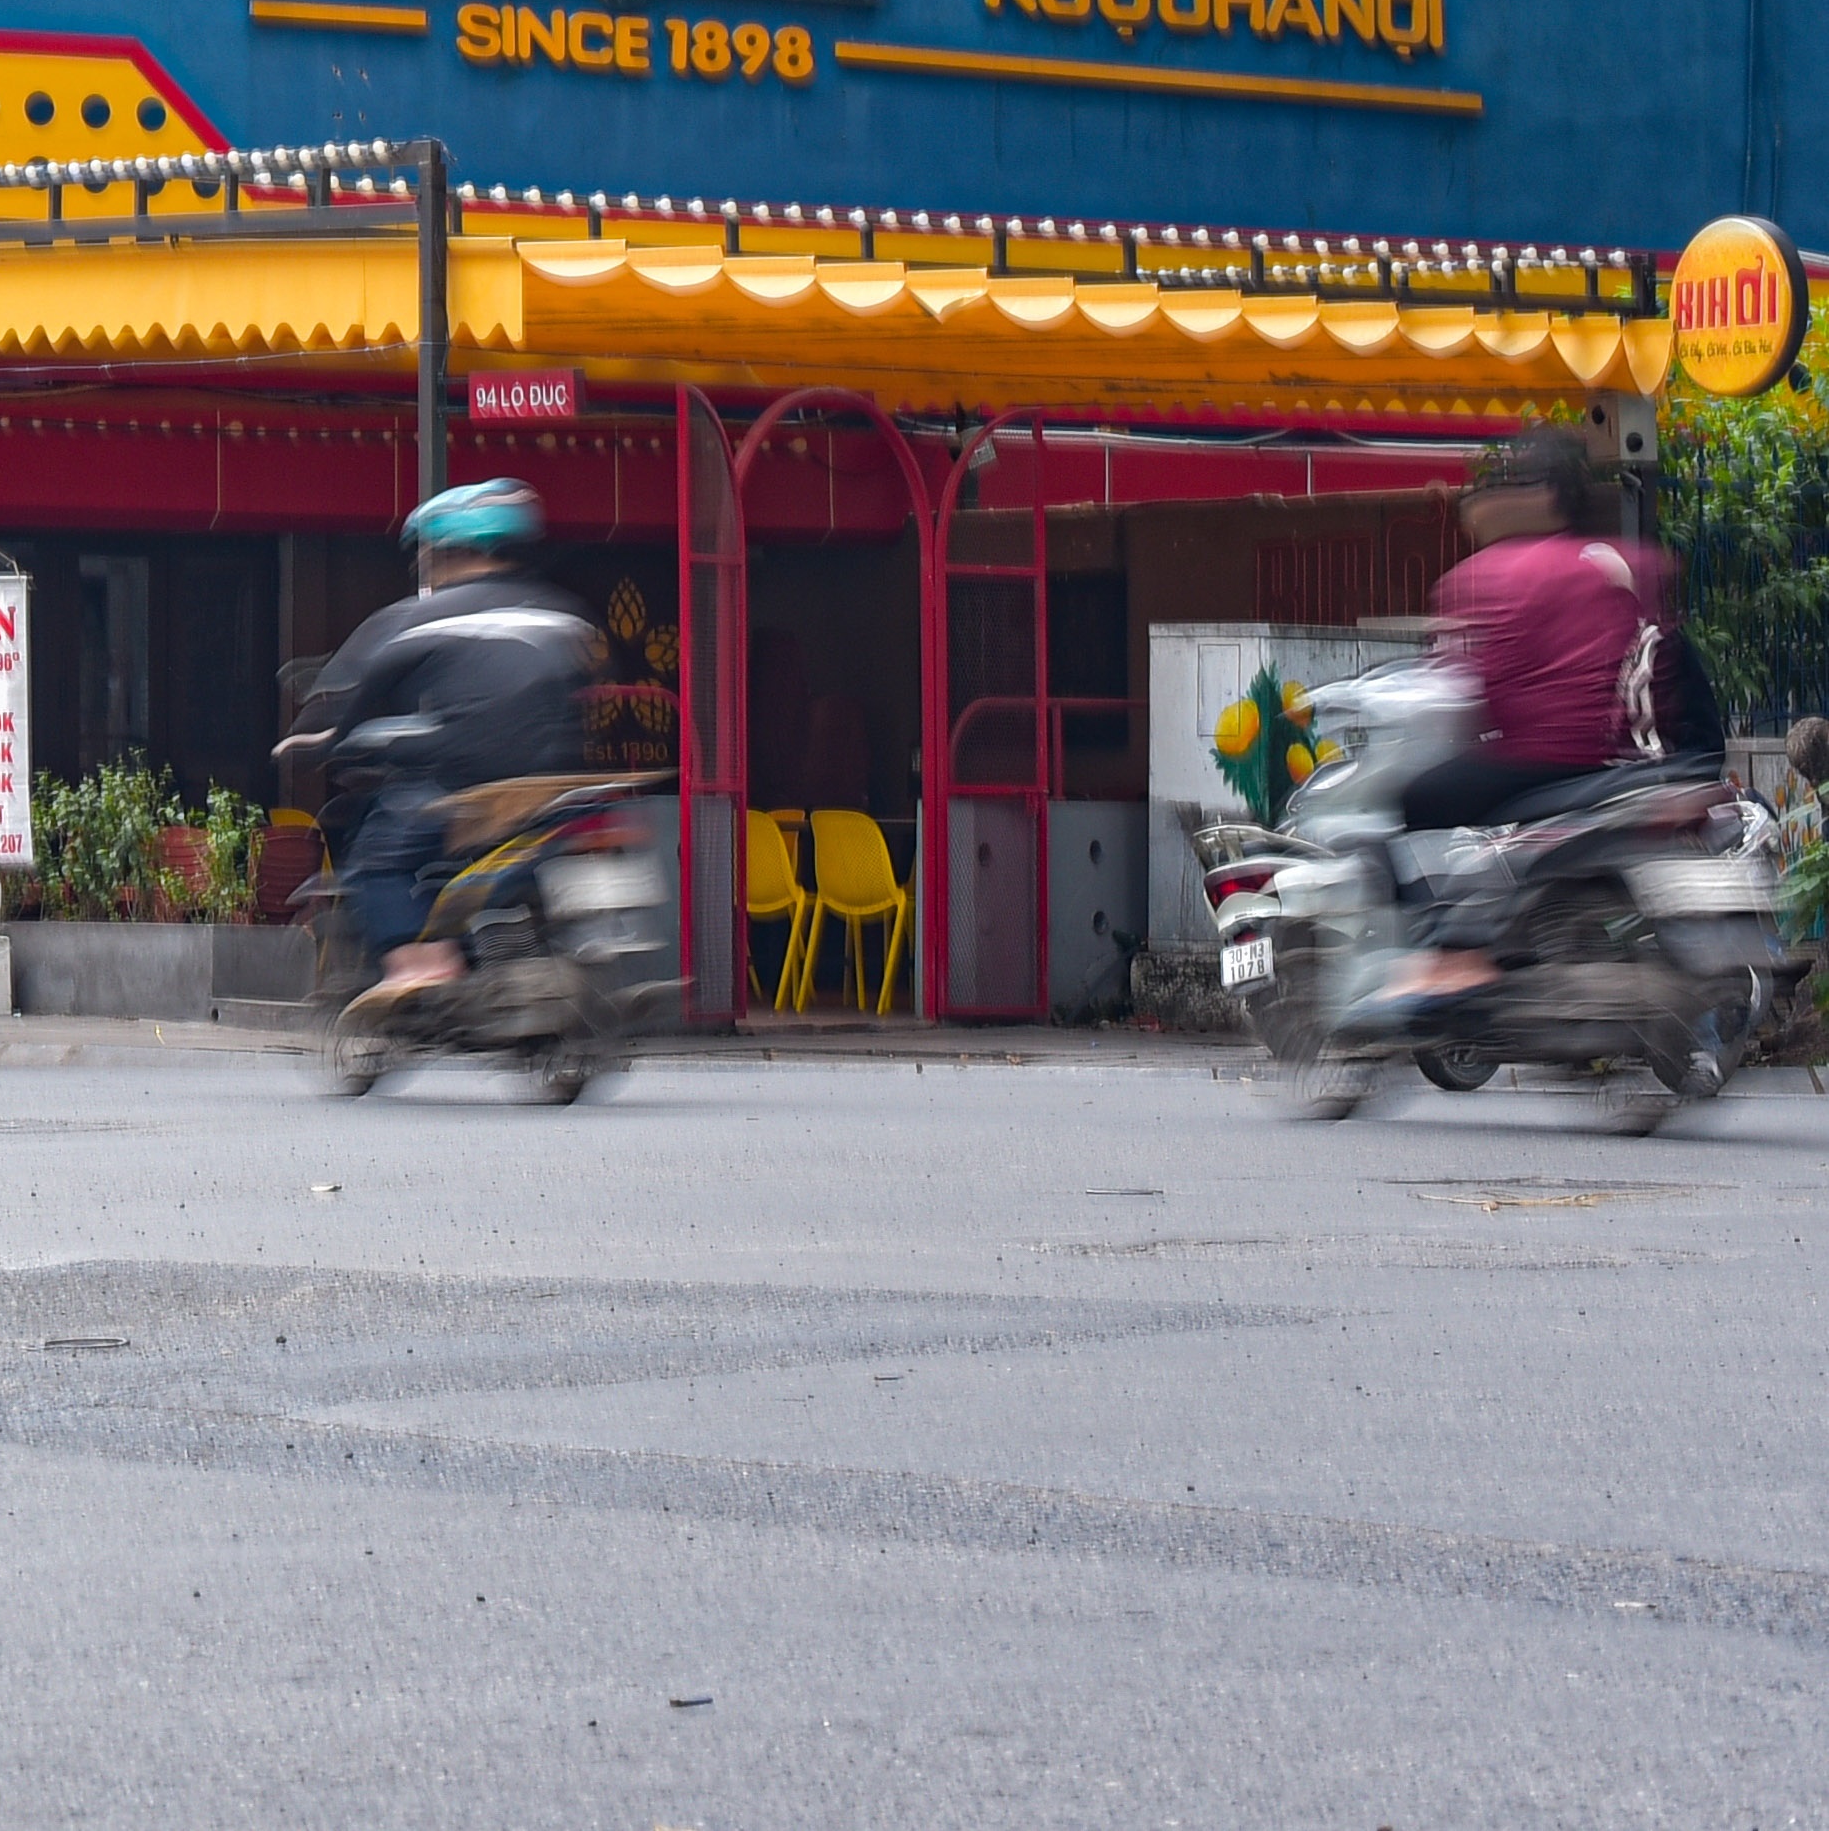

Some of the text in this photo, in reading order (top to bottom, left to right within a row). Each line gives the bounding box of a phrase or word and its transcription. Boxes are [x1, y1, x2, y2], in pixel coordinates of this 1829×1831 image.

[456, 2, 815, 84] SINCE 1898
[476, 379, 566, 408] 94 LÒ ĐÚC
[1231, 958, 1265, 981] 1078
